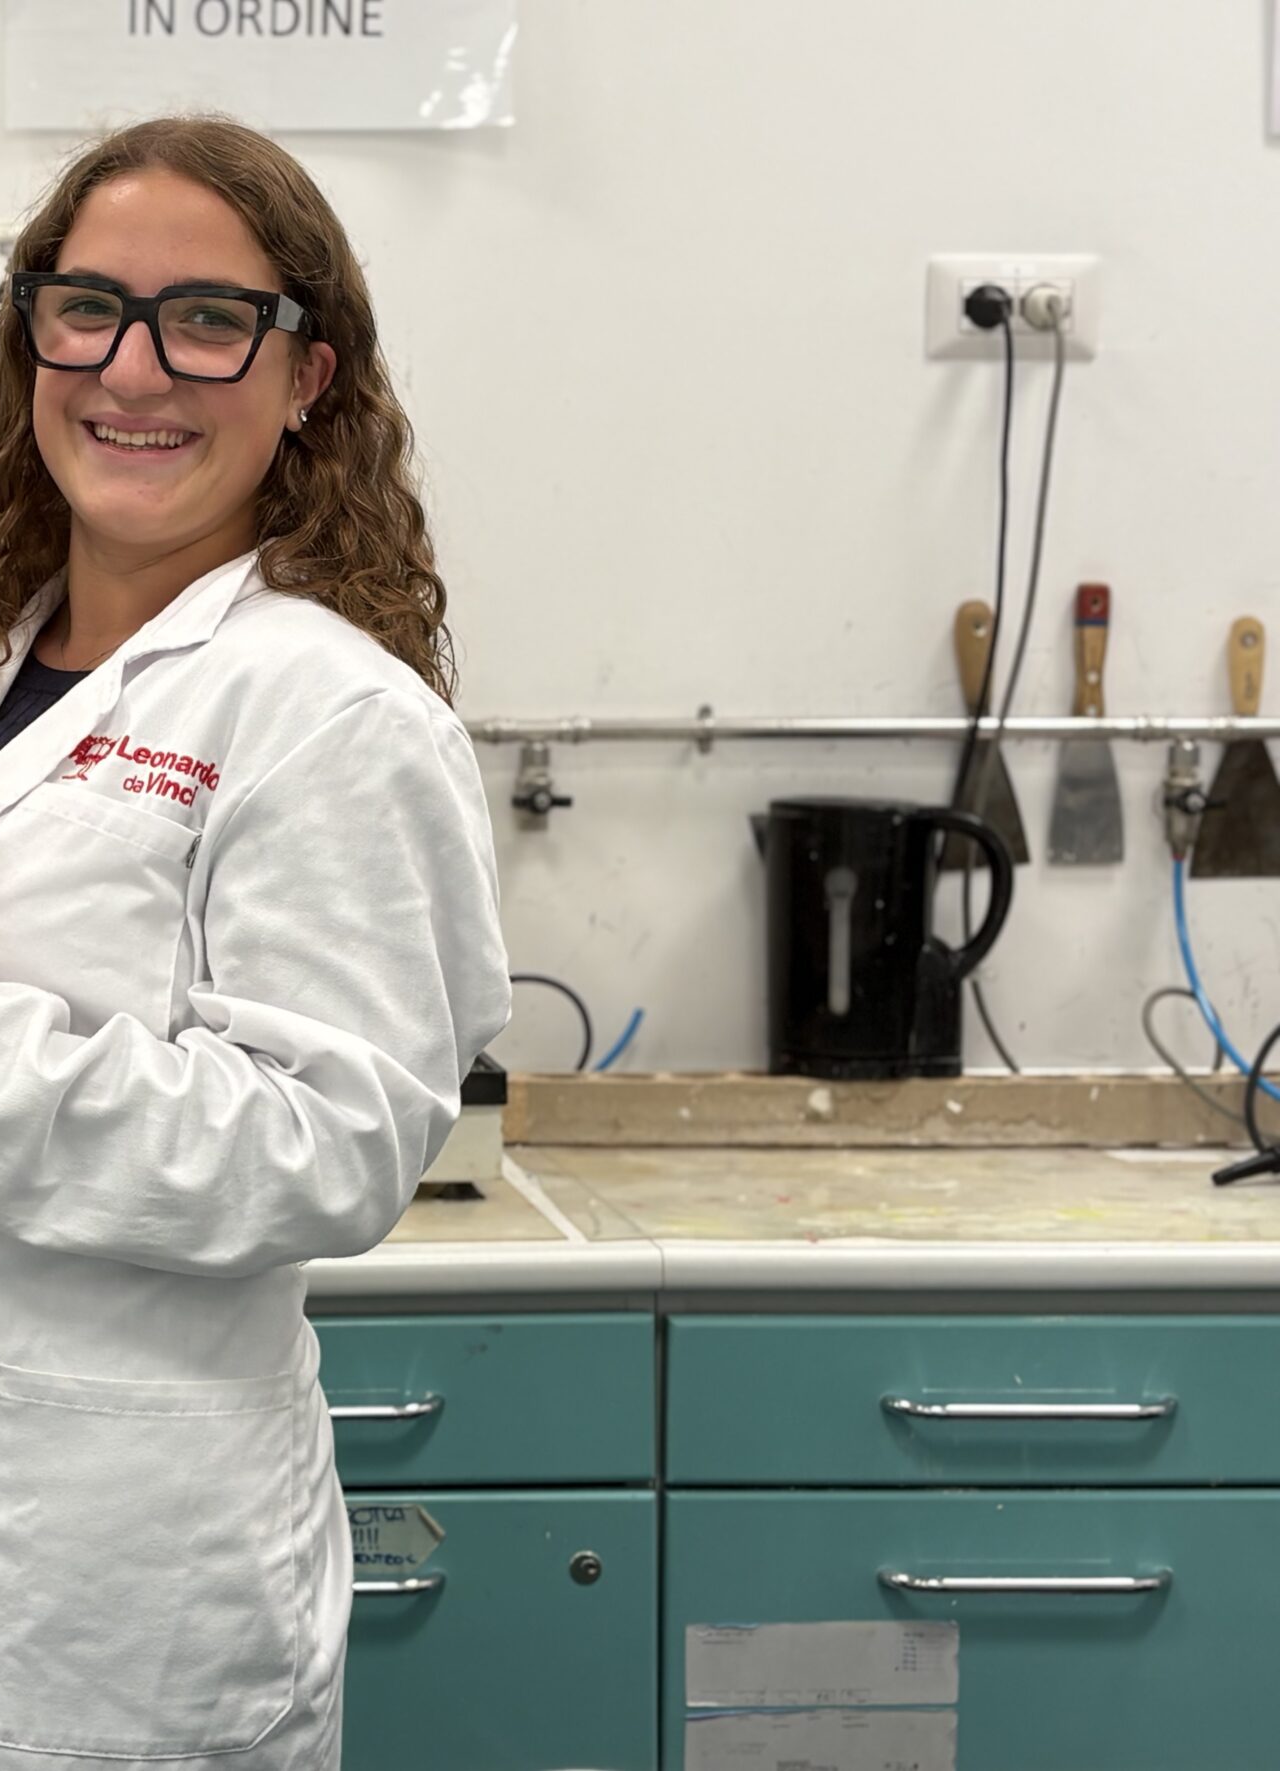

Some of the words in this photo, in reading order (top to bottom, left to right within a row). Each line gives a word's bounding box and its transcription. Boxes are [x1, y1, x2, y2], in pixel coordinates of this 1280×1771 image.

[129, 0, 174, 36] IN
[194, 0, 384, 37] ORDINE
[116, 734, 220, 792] Leonardo
